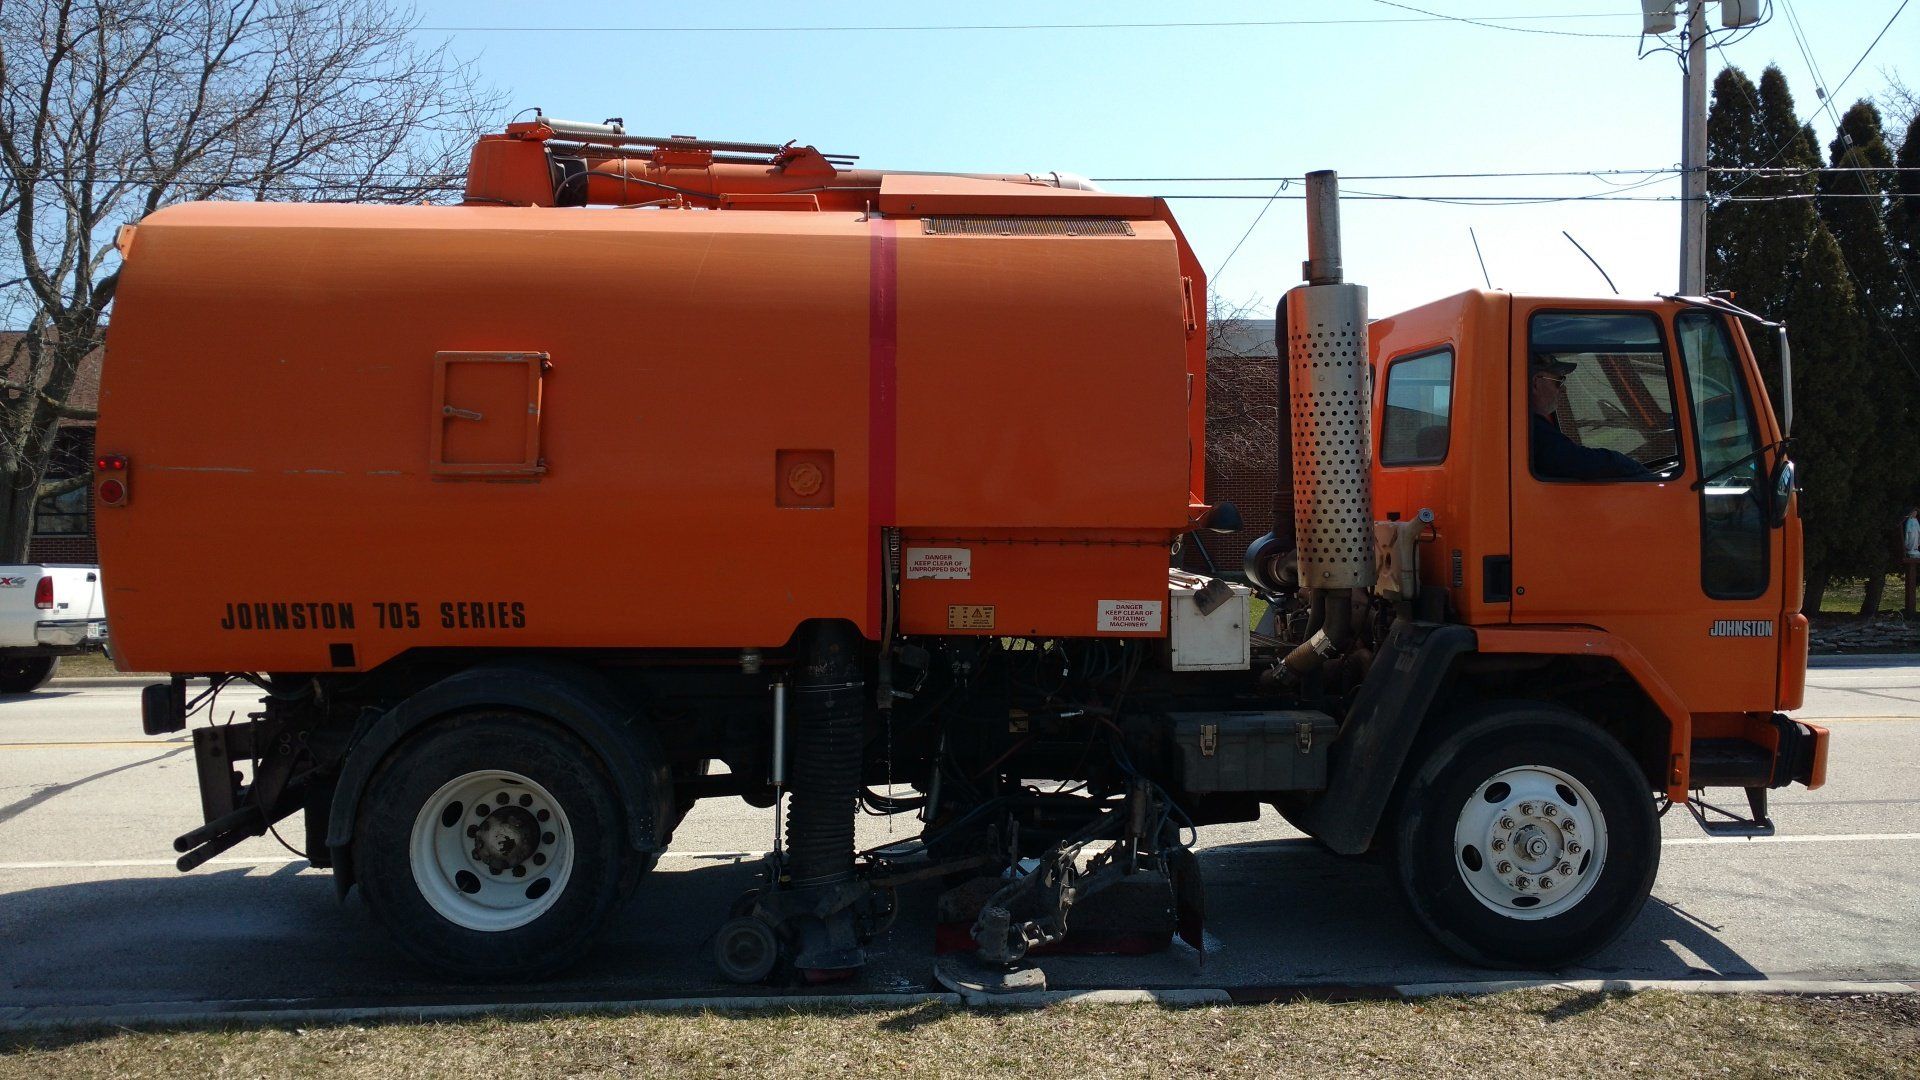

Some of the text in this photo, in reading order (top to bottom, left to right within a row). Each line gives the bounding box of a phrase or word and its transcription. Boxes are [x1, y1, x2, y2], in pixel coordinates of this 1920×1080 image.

[221, 601, 526, 630] JOHNSTON 705 SERIES
[1709, 620, 1774, 637] JOHNSTON
